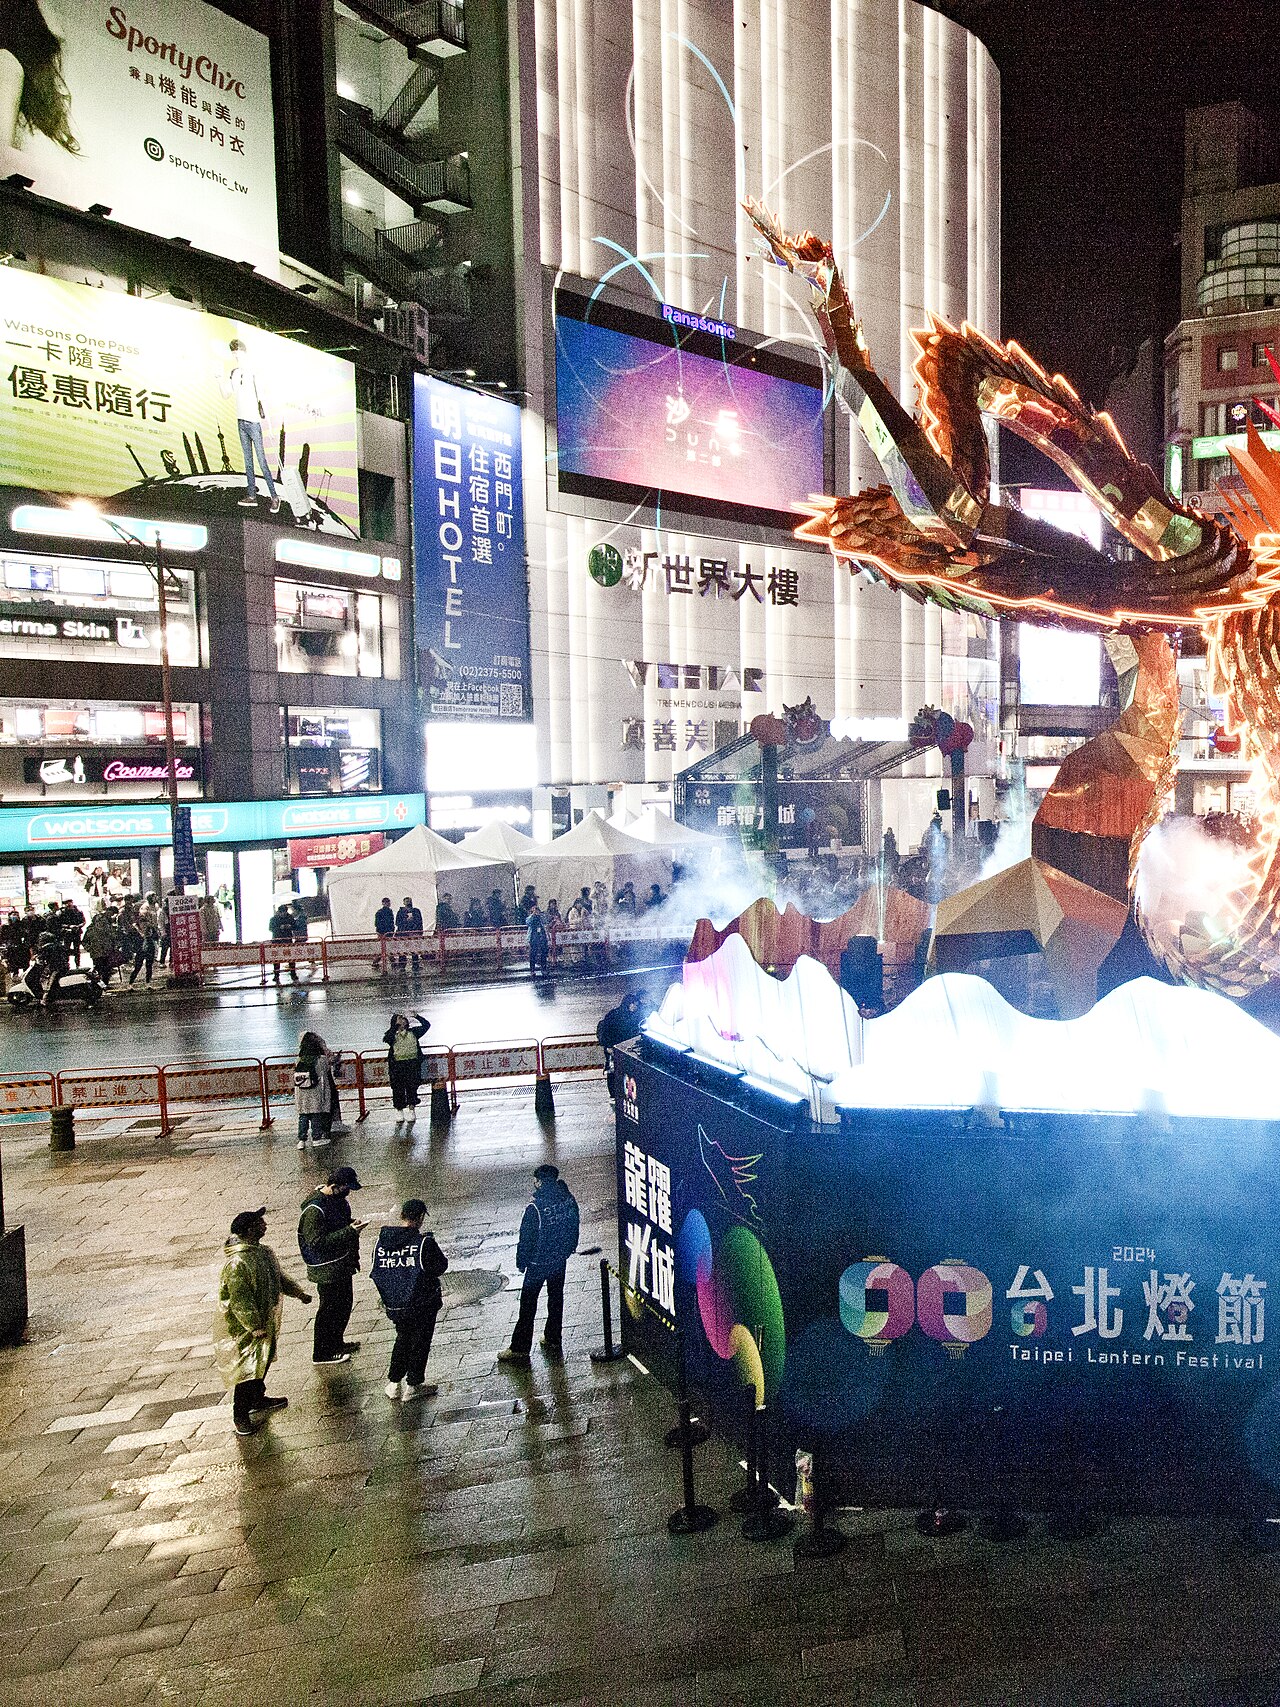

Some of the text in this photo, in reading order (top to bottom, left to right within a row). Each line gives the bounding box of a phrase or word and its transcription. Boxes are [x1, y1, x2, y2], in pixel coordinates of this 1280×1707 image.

[105, 6, 246, 99] SportyChic
[129, 66, 246, 131] 兼具機能與美的
[166, 105, 245, 156] 運動內衣
[169, 154, 249, 194] sportychic_tw
[4, 318, 71, 342] Watsons
[661, 303, 736, 340] Panasonic
[6, 340, 122, 374] 一卡隨享
[8, 365, 172, 422] 優惠隨行
[430, 394, 463, 649] 明日 HOTEL
[468, 442, 493, 565] 住宿首選
[63, 621, 110, 638] Skin
[44, 817, 153, 835] watsons
[463, 1055, 528, 1071] 禁止進入
[72, 1083, 149, 1099] 禁止進入
[624, 1140, 673, 1236] 龍躍
[377, 1245, 419, 1257] STAFF
[379, 1256, 416, 1269] 工作人員
[624, 1222, 676, 1317] 光城
[1112, 1246, 1156, 1262] 2024
[1005, 1264, 1268, 1346] 台北燈節
[1010, 1344, 1264, 1369] Taipei Lantern Festival
